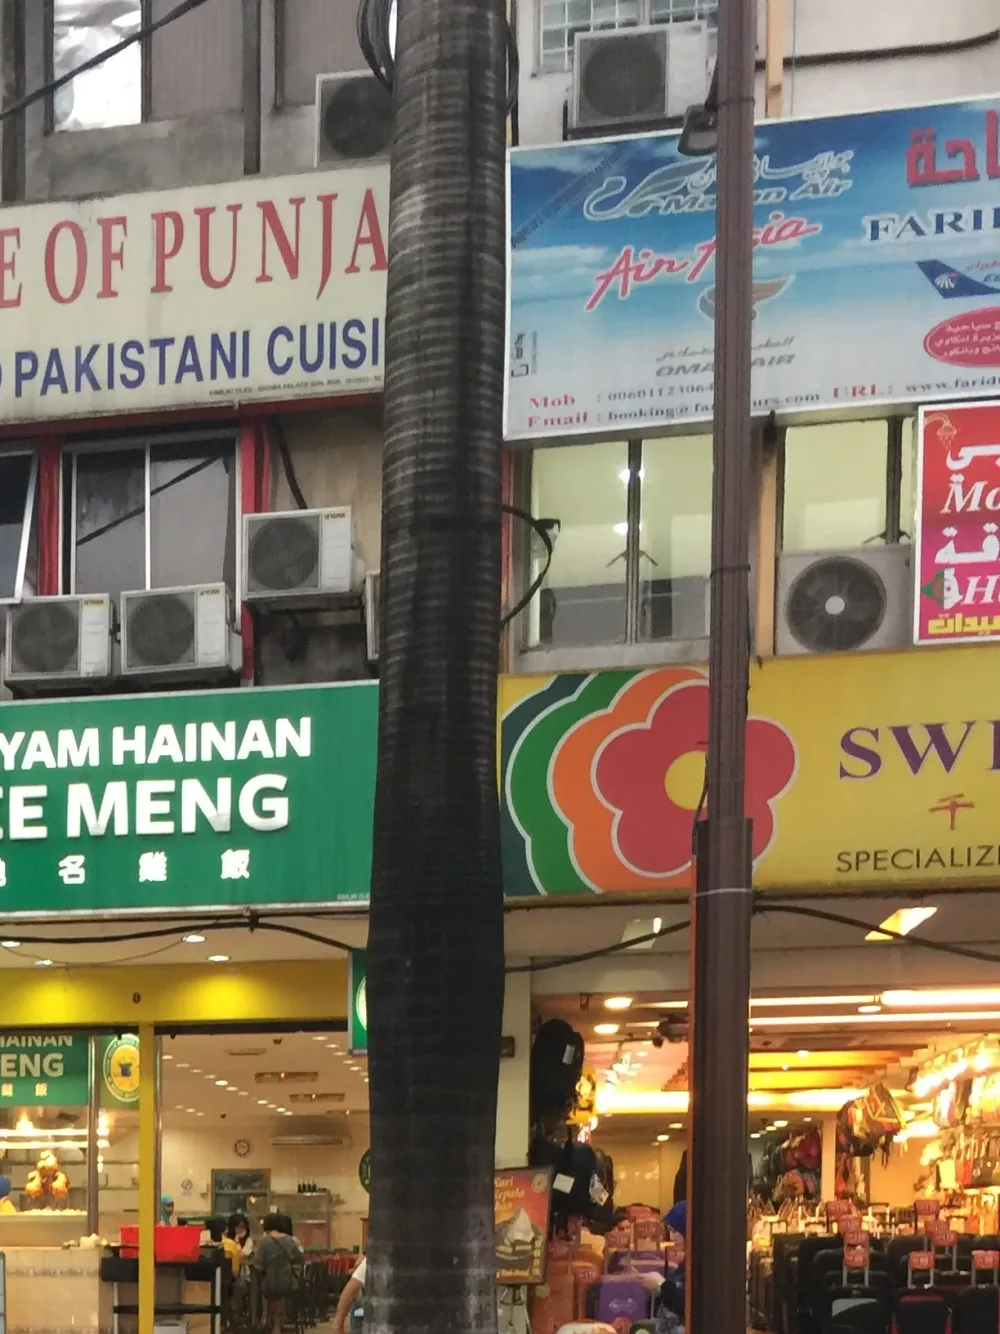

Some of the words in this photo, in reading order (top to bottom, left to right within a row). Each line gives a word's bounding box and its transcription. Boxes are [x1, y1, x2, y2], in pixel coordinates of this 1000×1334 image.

[44, 216, 127, 304] OF
[150, 188, 388, 300] PUNJA
[15, 330, 250, 397] PAKISTANI
[267, 318, 379, 376] CUISI
[656, 362, 715, 377] OMA
[529, 394, 576, 409] Mob
[960, 574, 1000, 605] H
[112, 716, 312, 766] HAINAN
[66, 773, 290, 839] MENG
[836, 845, 1000, 873] SPECIALIZ
